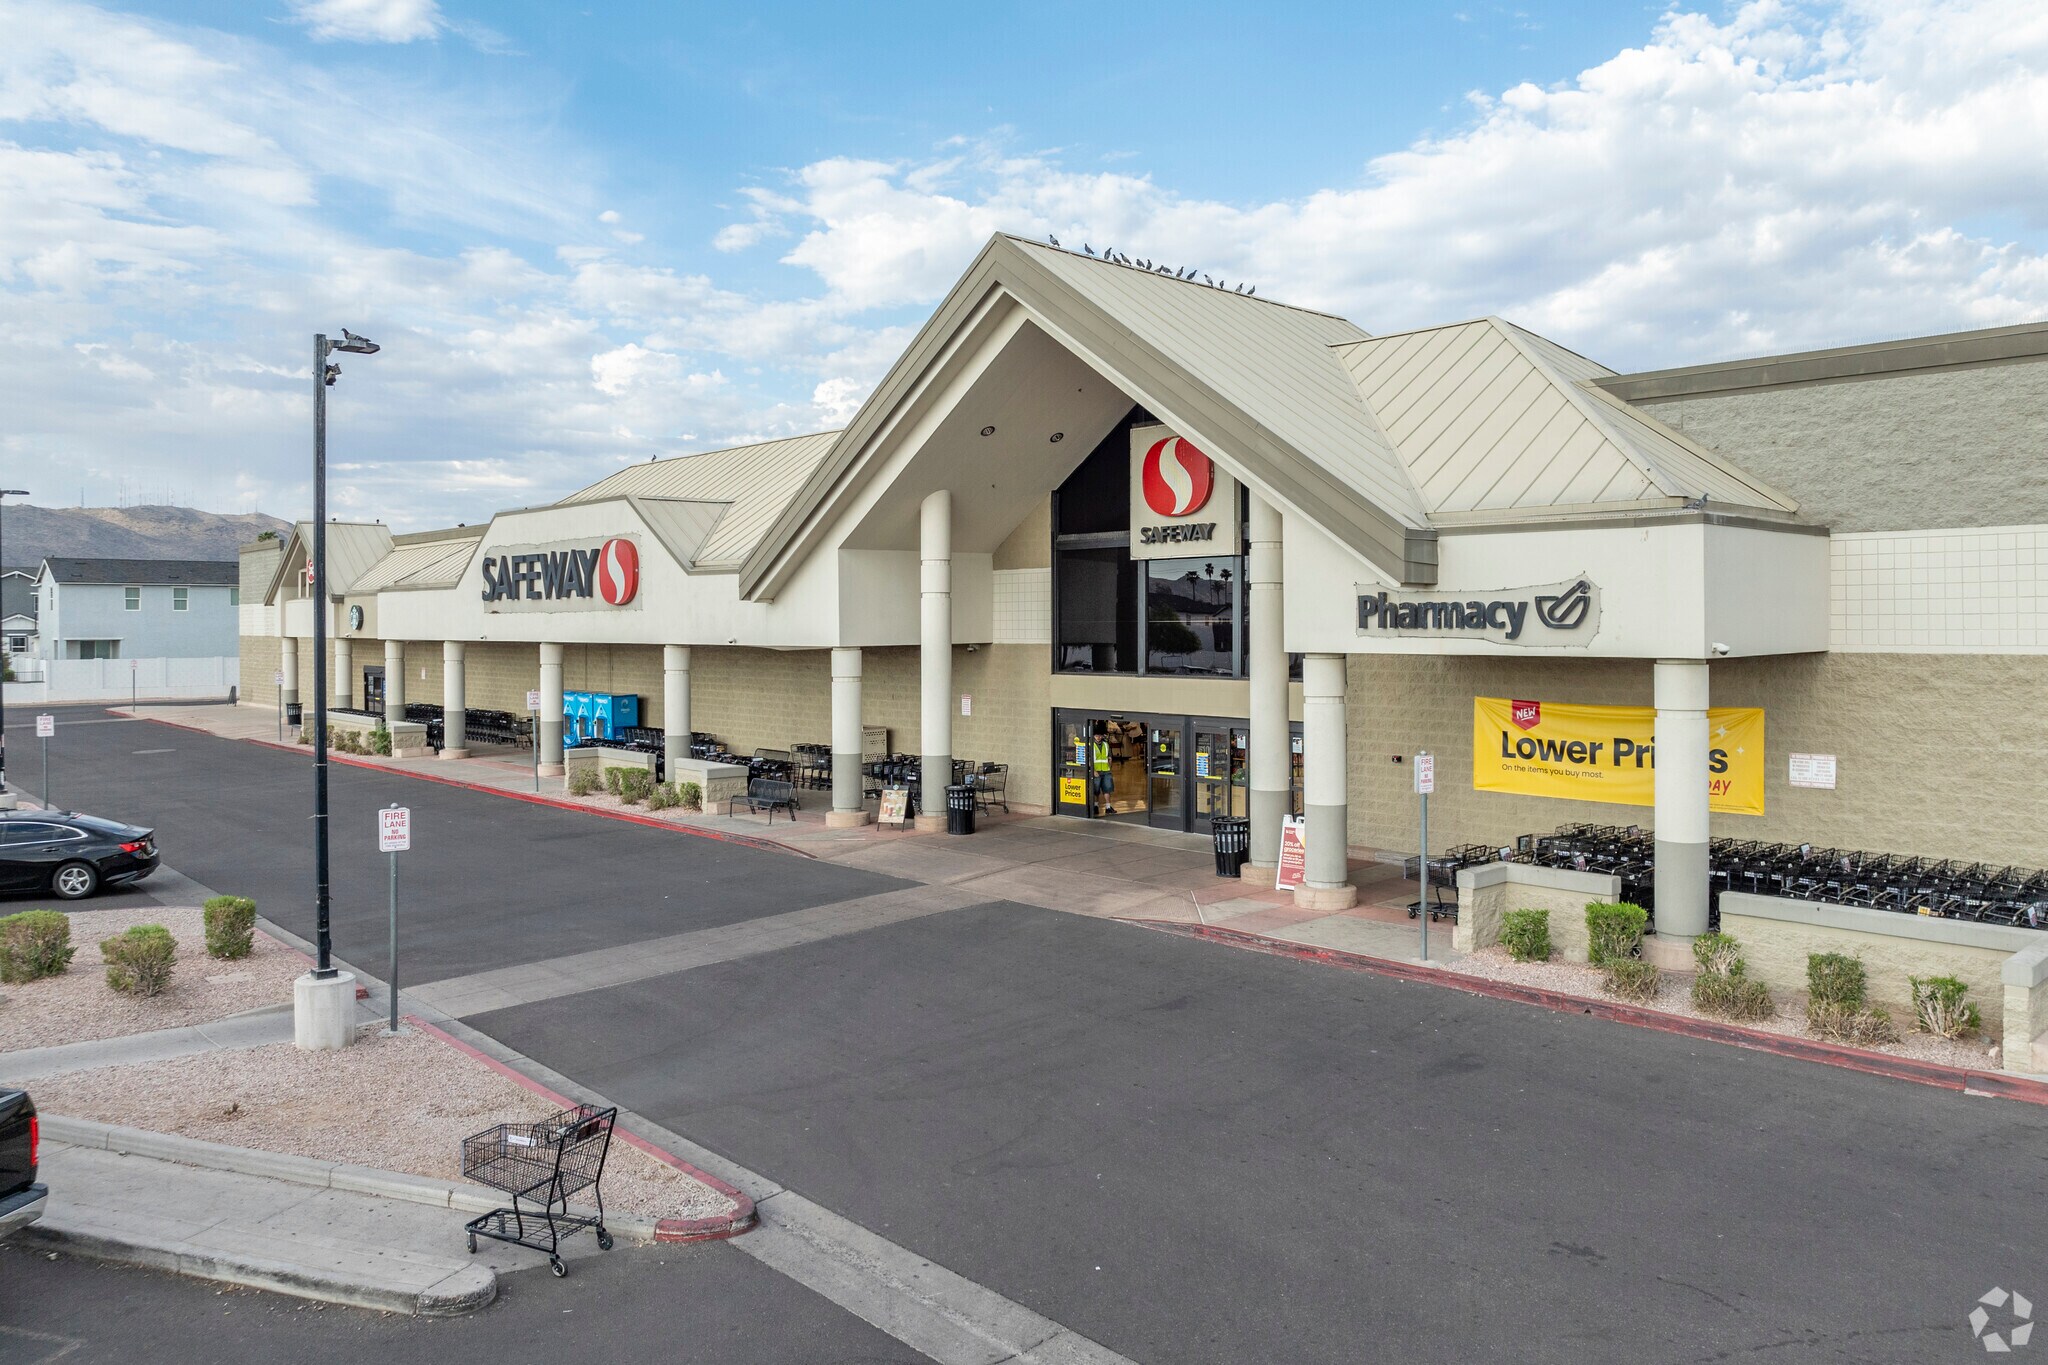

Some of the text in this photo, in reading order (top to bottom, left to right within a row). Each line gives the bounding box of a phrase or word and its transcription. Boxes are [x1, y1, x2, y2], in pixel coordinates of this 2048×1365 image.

[1140, 523, 1217, 544] SAFEWAY
[482, 548, 601, 602] SAFEWAY
[1358, 592, 1528, 640] Pharmacy
[1516, 706, 1536, 719] NEW
[1502, 731, 1603, 764] Lower
[1421, 757, 1432, 765] FIRE
[1514, 764, 1526, 772] the
[1527, 765, 1548, 774] items
[1549, 769, 1564, 777] you
[1565, 769, 1580, 778] buy
[1581, 770, 1604, 778] most.
[1065, 790, 1081, 798] Prices
[385, 812, 406, 820] FIRE
[385, 820, 407, 828] LANE
